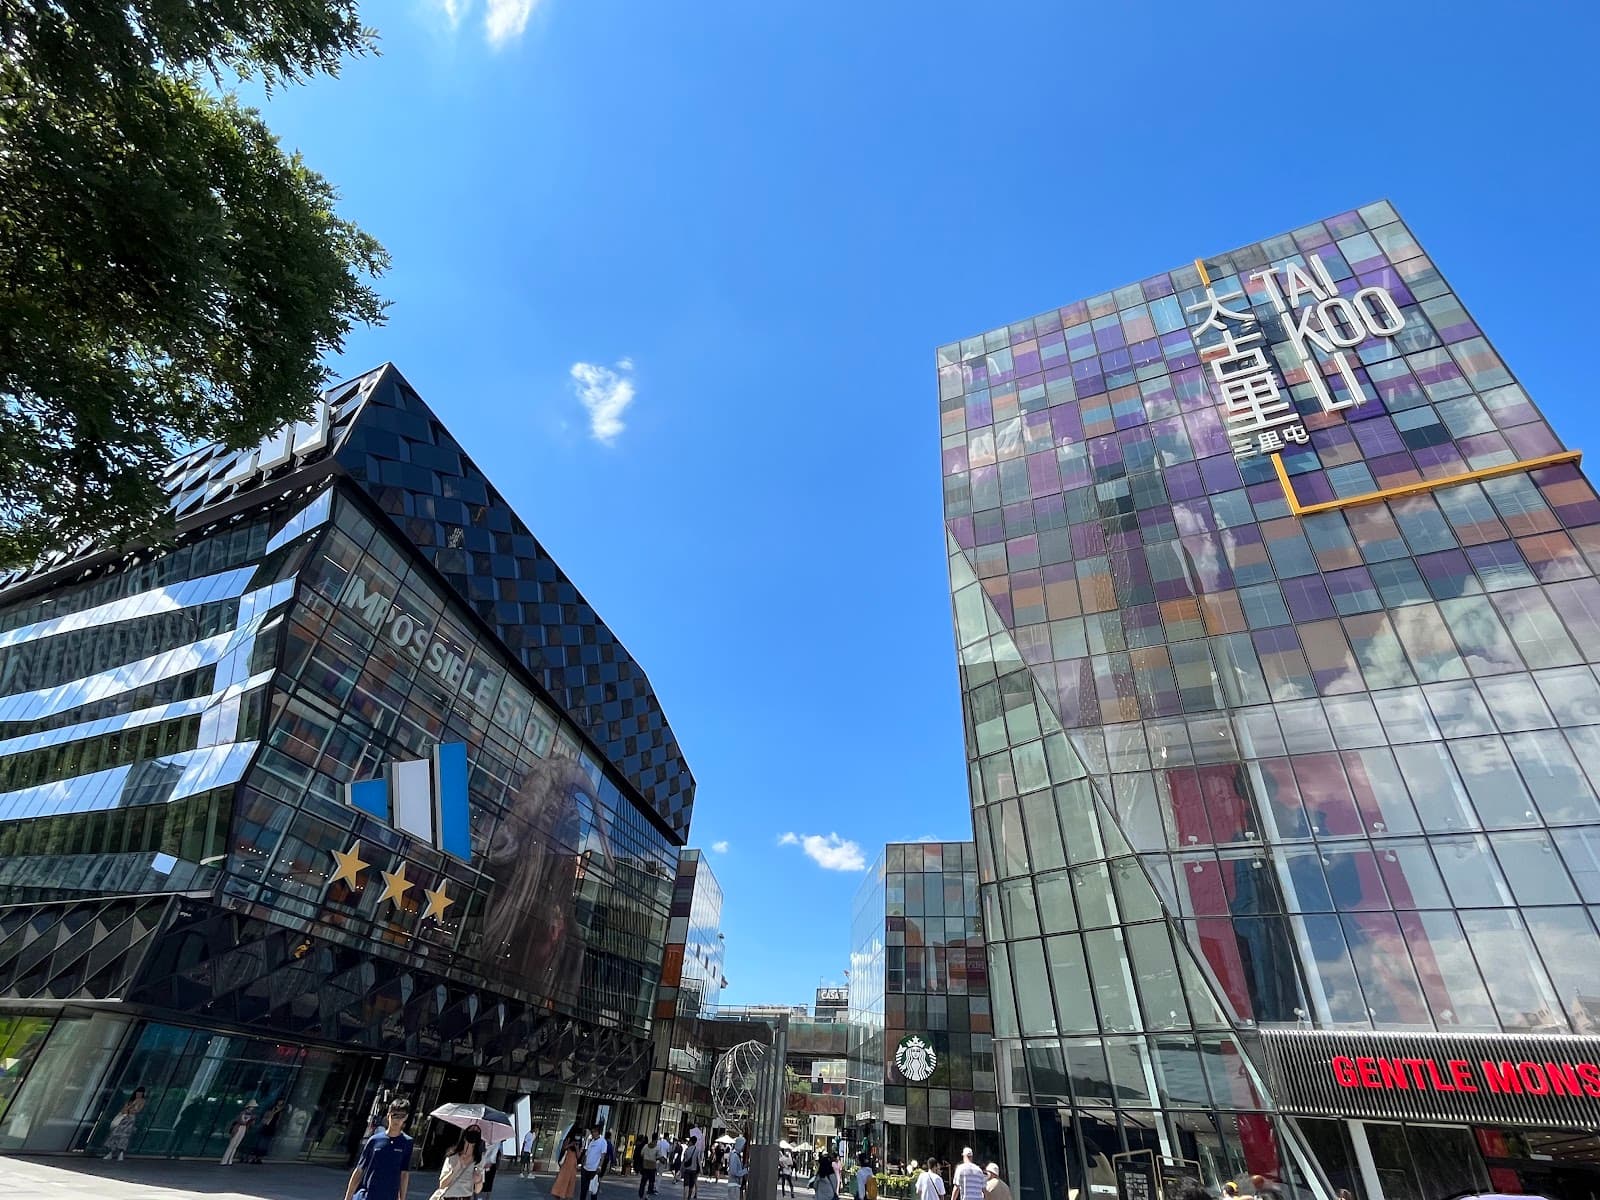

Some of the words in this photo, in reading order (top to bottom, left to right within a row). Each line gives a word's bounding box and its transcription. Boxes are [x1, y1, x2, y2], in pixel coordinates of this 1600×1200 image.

[1250, 254, 1339, 314] TAI
[1281, 286, 1406, 360] KOO
[1186, 286, 1300, 437] 太古里
[1303, 352, 1367, 414] LI
[1231, 424, 1310, 459] 三里屯
[821, 991, 840, 1000] CASA
[1331, 1055, 1478, 1093] GENTLE
[1480, 1059, 1600, 1098] MONS
